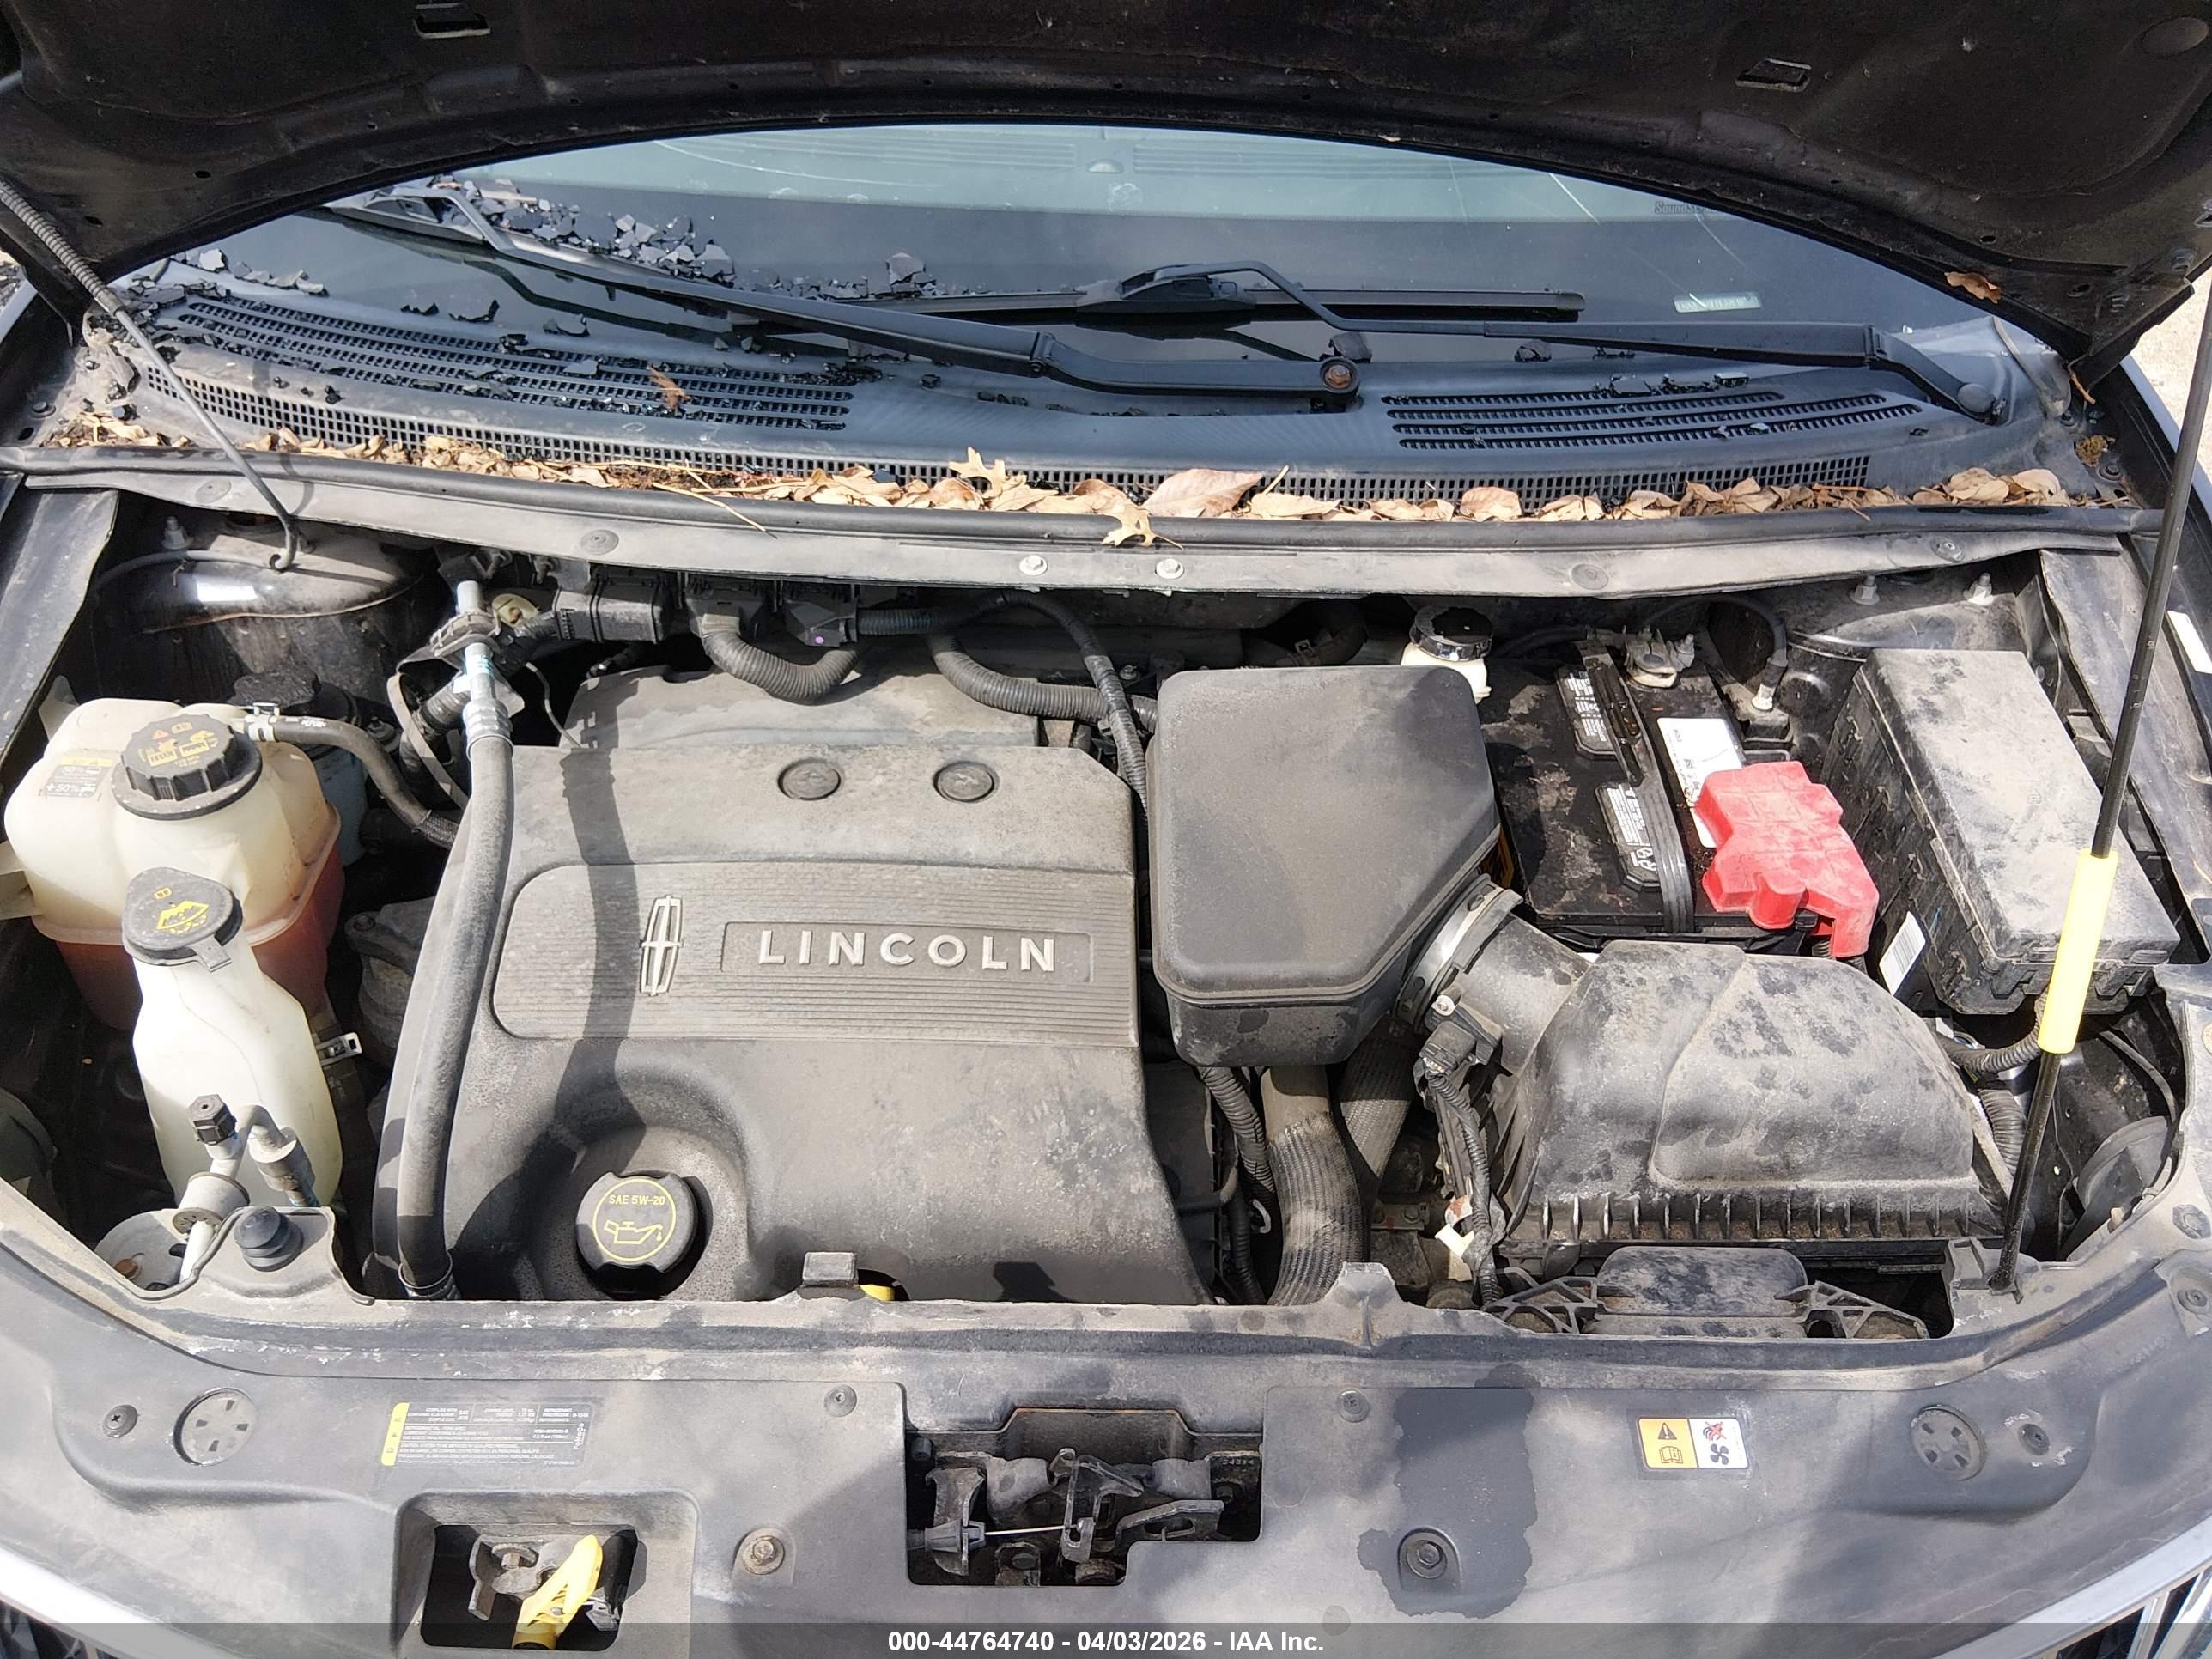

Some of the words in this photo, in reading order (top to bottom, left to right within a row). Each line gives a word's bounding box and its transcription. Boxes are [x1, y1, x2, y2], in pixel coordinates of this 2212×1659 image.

[758, 929, 1055, 972] LINCOLN
[609, 1194, 629, 1206] SAE
[631, 1194, 666, 1206] 5W-20
